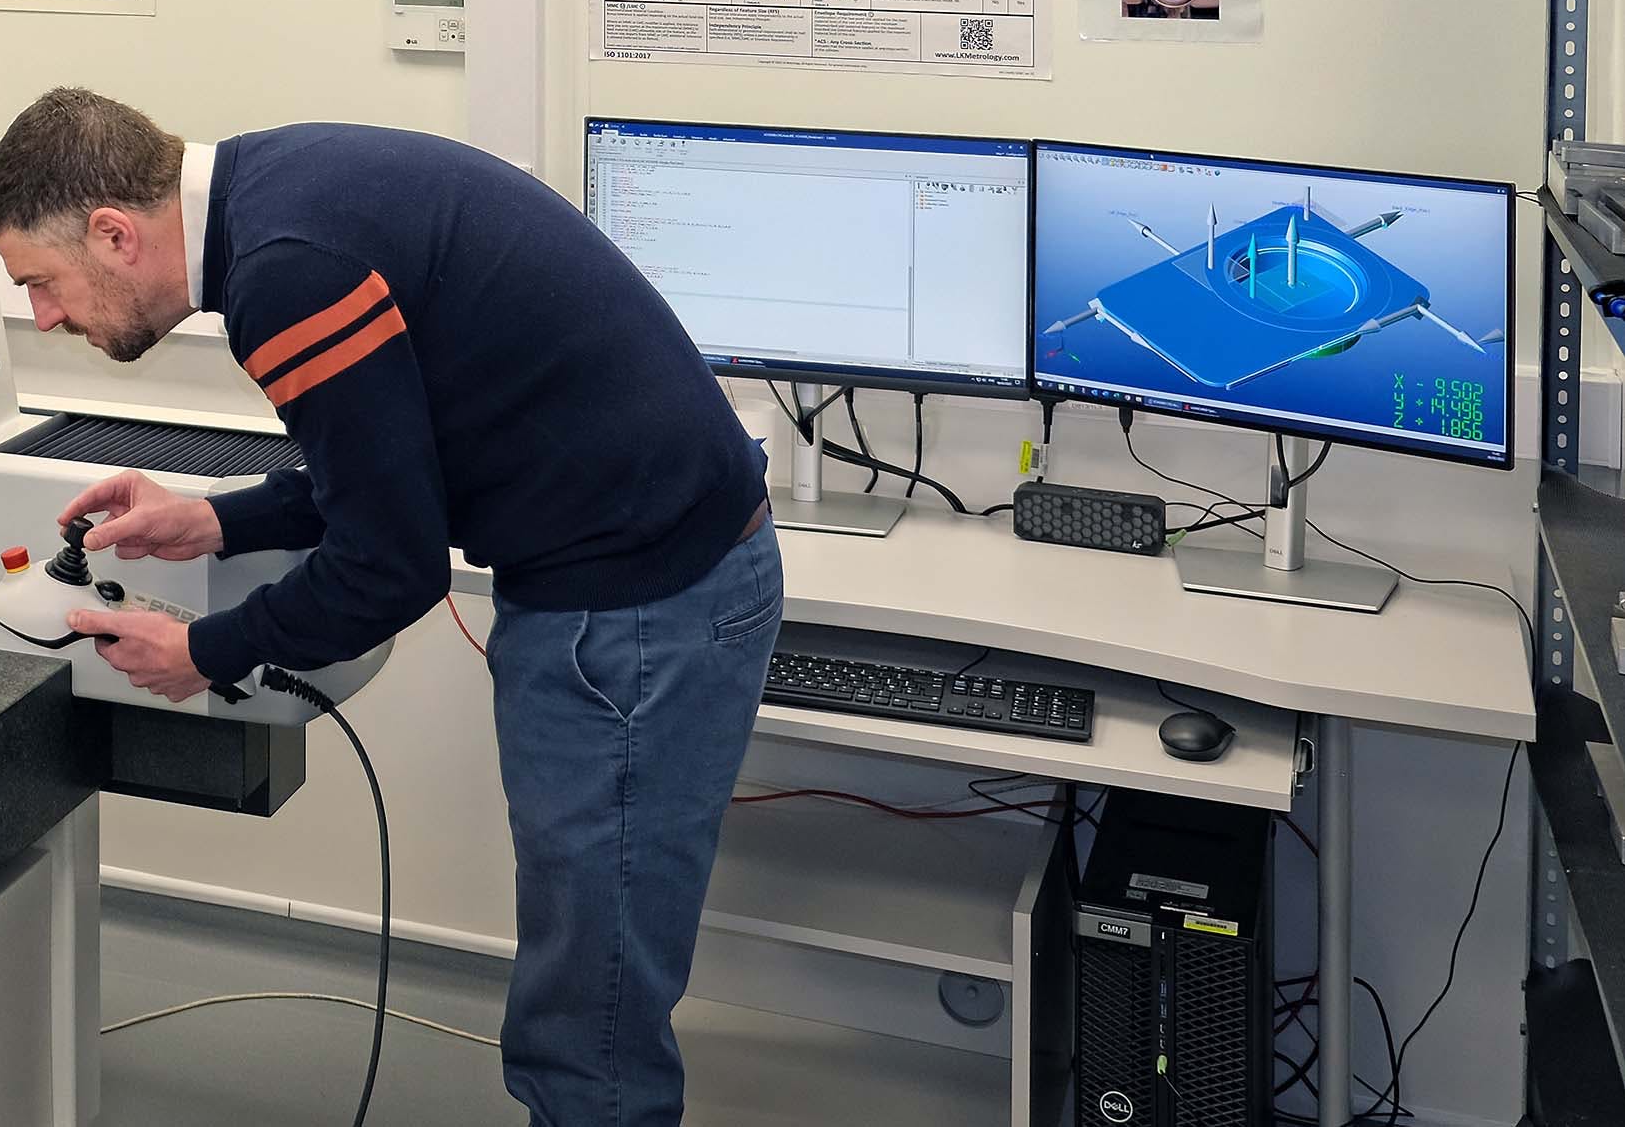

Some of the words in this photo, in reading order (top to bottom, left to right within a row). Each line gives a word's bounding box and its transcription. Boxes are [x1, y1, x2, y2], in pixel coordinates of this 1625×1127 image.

[935, 52, 1019, 61] www.LKMetrology.com
[1394, 374, 1404, 390] X
[1435, 378, 1484, 402] 9.502
[1394, 412, 1404, 428] Z
[1441, 419, 1482, 441] 1.856
[1100, 924, 1128, 936] CMM7
[1104, 1100, 1129, 1114] DELL
